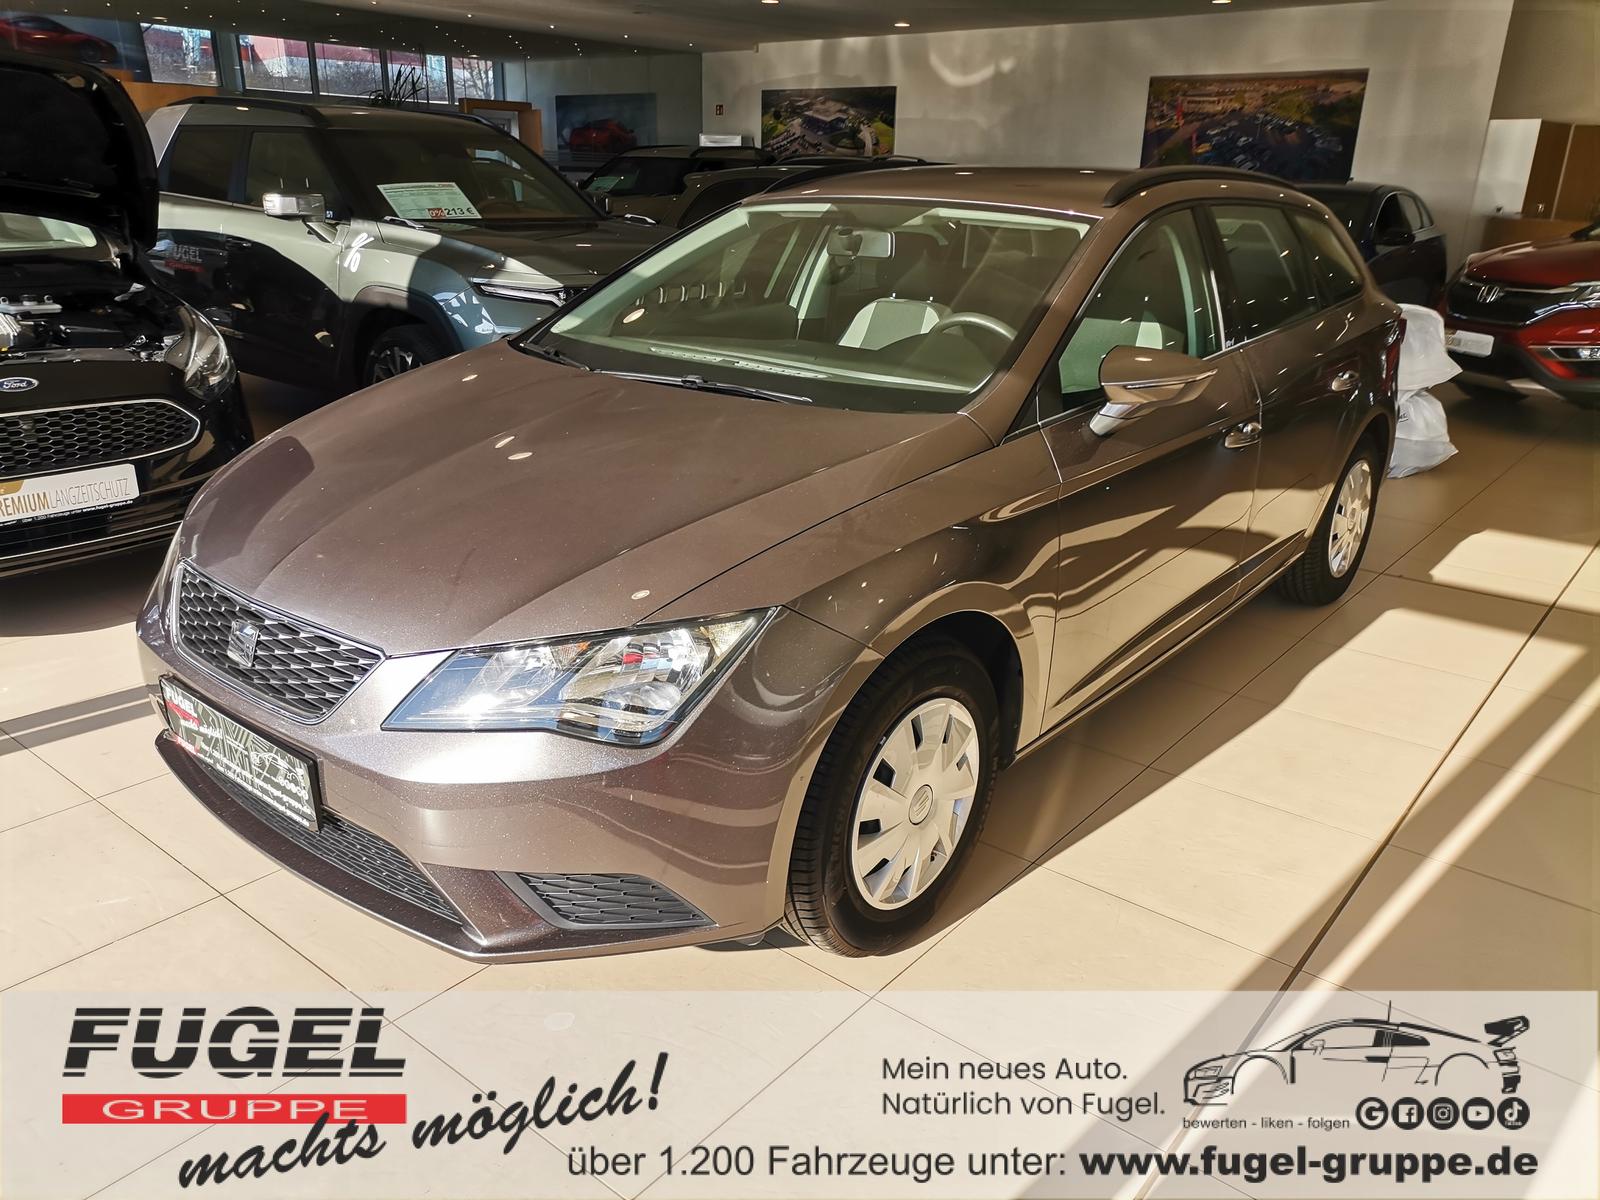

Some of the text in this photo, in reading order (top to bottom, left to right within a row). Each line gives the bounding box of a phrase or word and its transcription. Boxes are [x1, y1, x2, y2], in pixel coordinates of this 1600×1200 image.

[444, 207, 465, 216] 213
[467, 207, 475, 215] €
[3, 380, 28, 389] Ford
